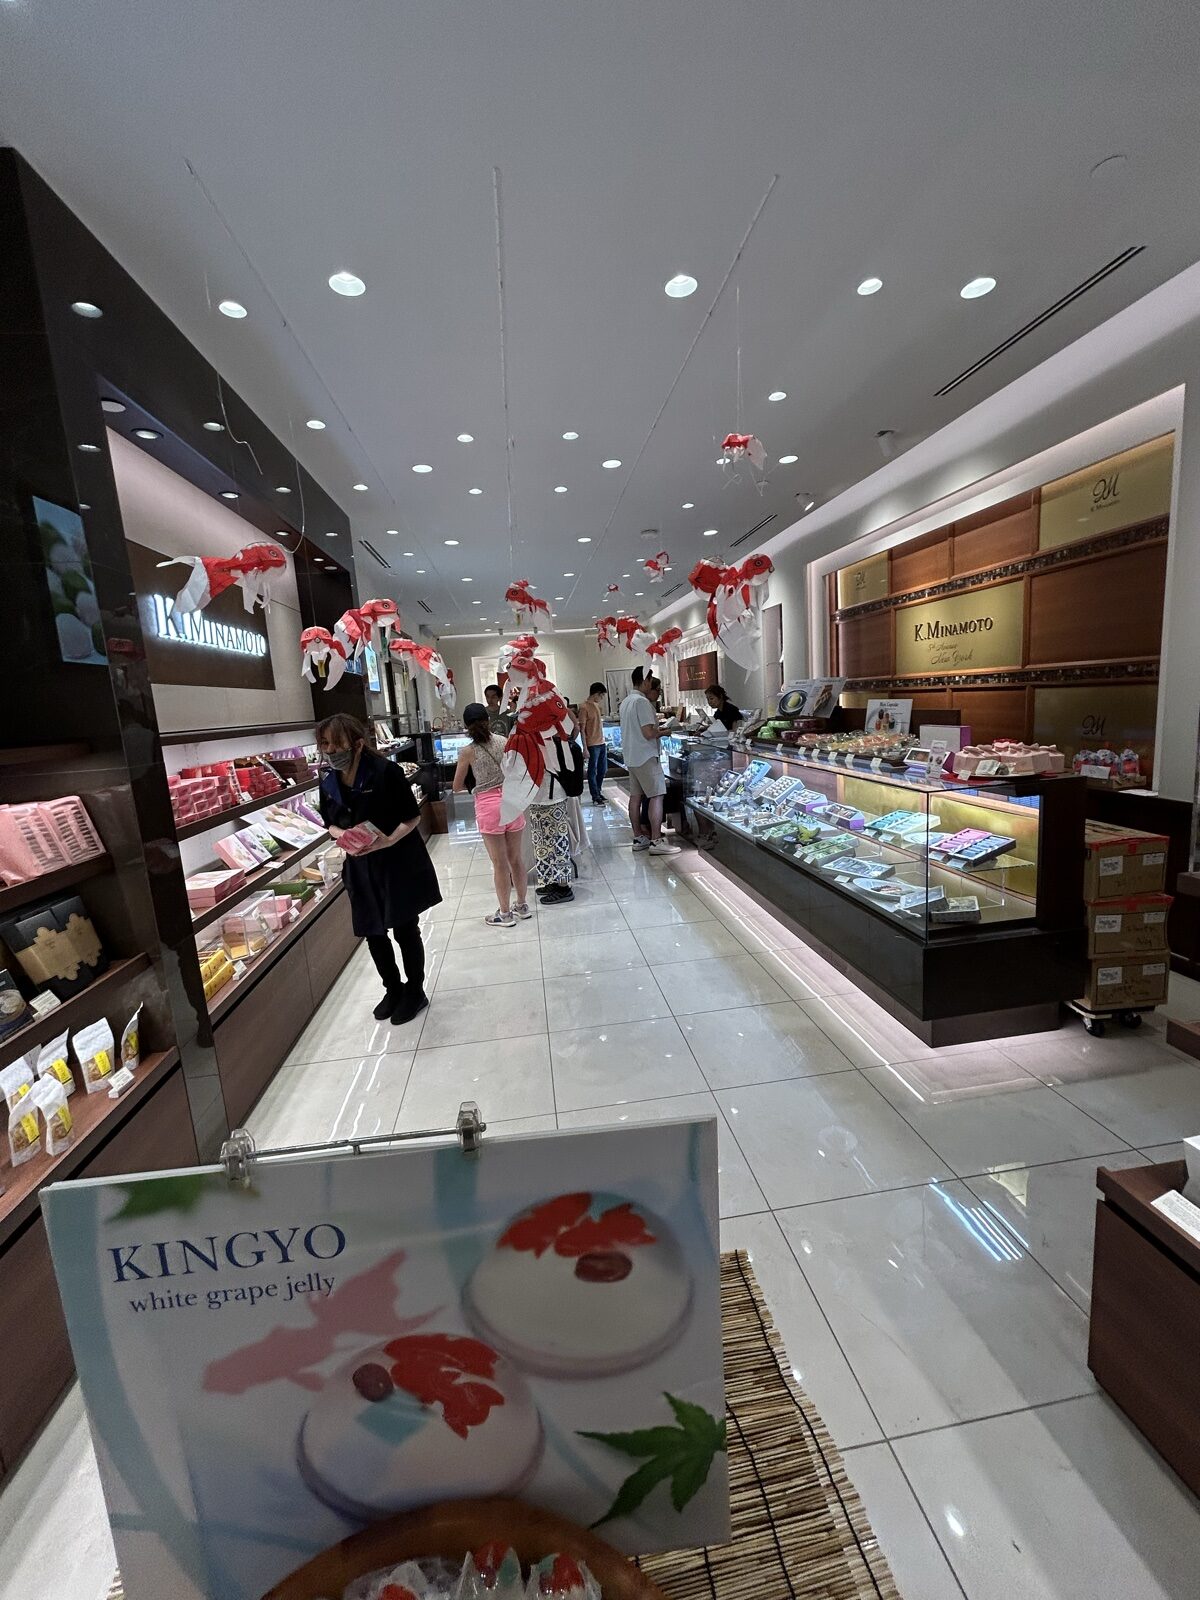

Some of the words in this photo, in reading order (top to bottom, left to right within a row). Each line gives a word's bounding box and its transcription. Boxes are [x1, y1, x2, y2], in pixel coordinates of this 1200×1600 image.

[914, 617, 994, 642] K.MINAMOTO
[107, 1223, 346, 1283] KINGYO
[129, 1290, 198, 1313] white
[206, 1283, 278, 1310] grape
[283, 1272, 335, 1301] jelly
